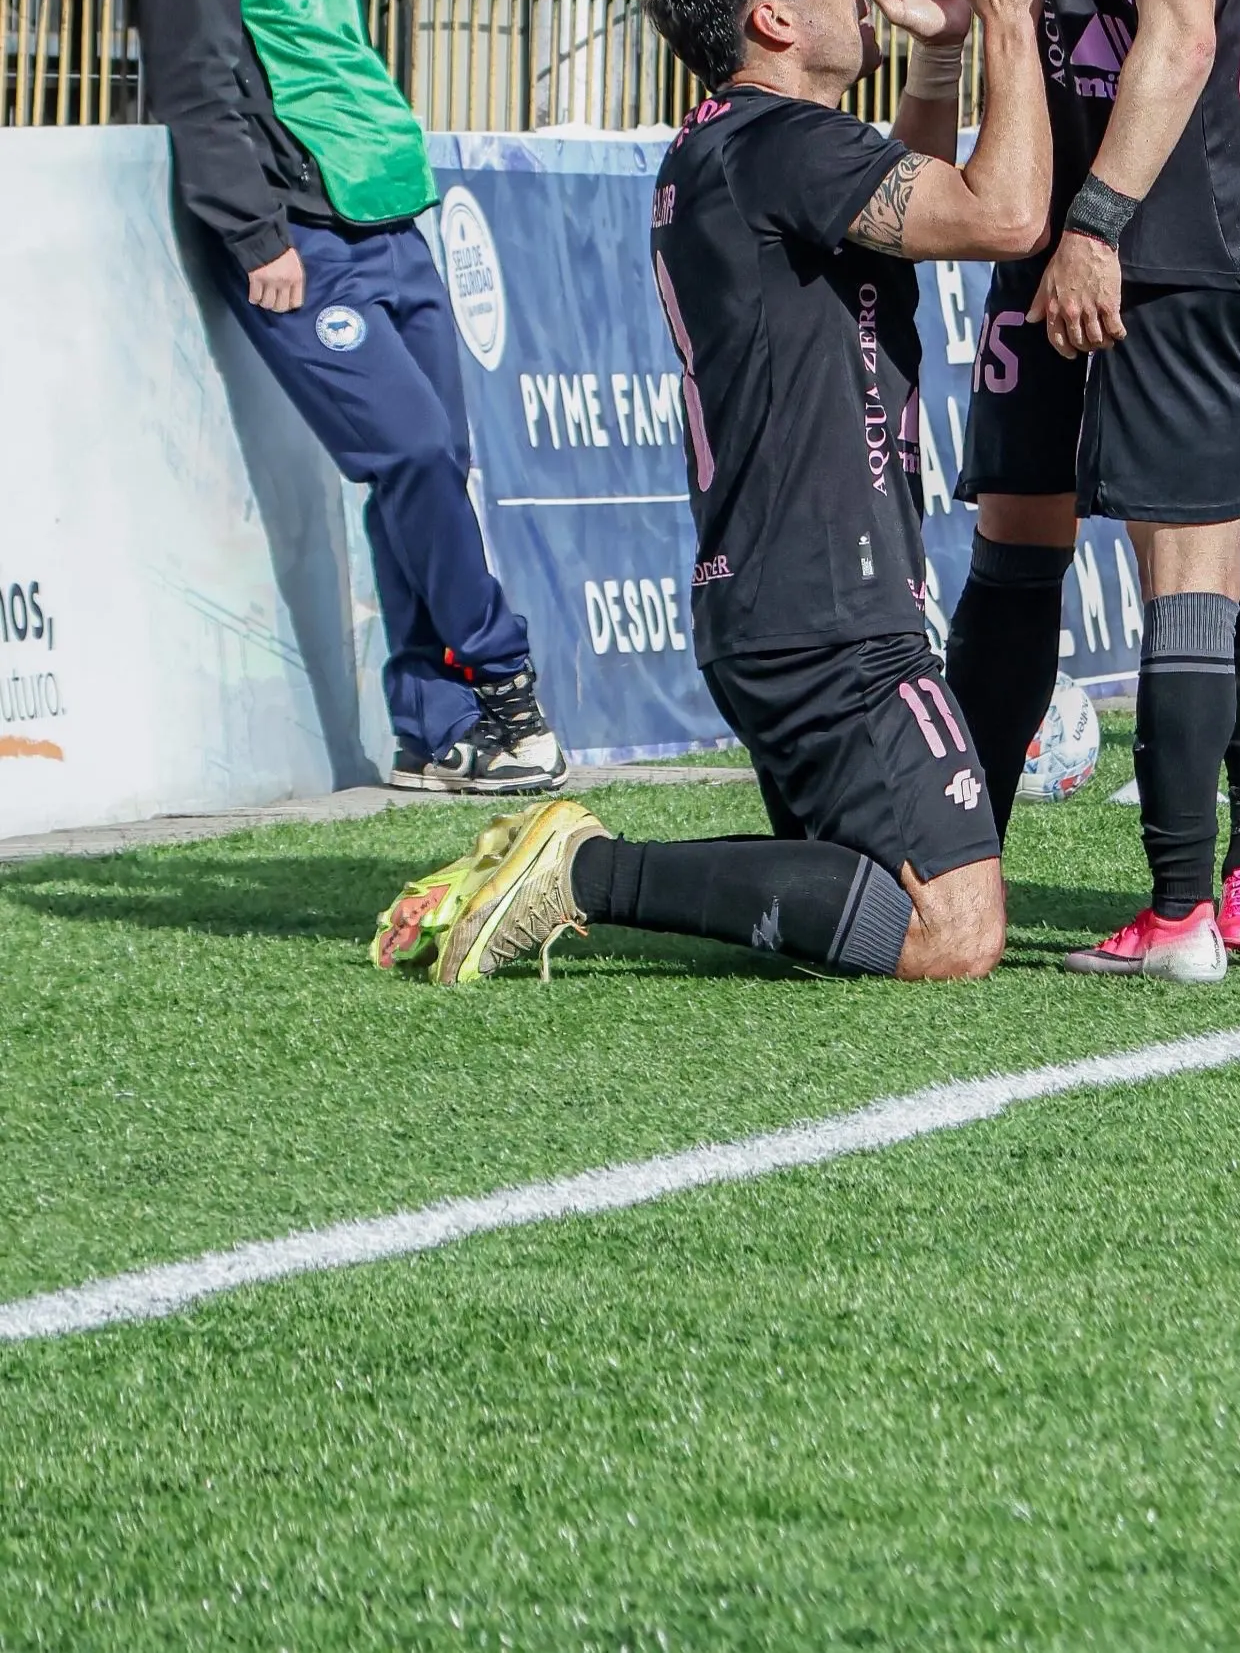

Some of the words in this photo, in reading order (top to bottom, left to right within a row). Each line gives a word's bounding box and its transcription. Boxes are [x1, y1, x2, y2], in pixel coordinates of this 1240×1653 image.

[858, 282, 878, 375] ZERO
[520, 373, 609, 450] PYME
[584, 577, 687, 655] DESDE
[0, 669, 67, 722] uturo.
[899, 678, 967, 759] 11
